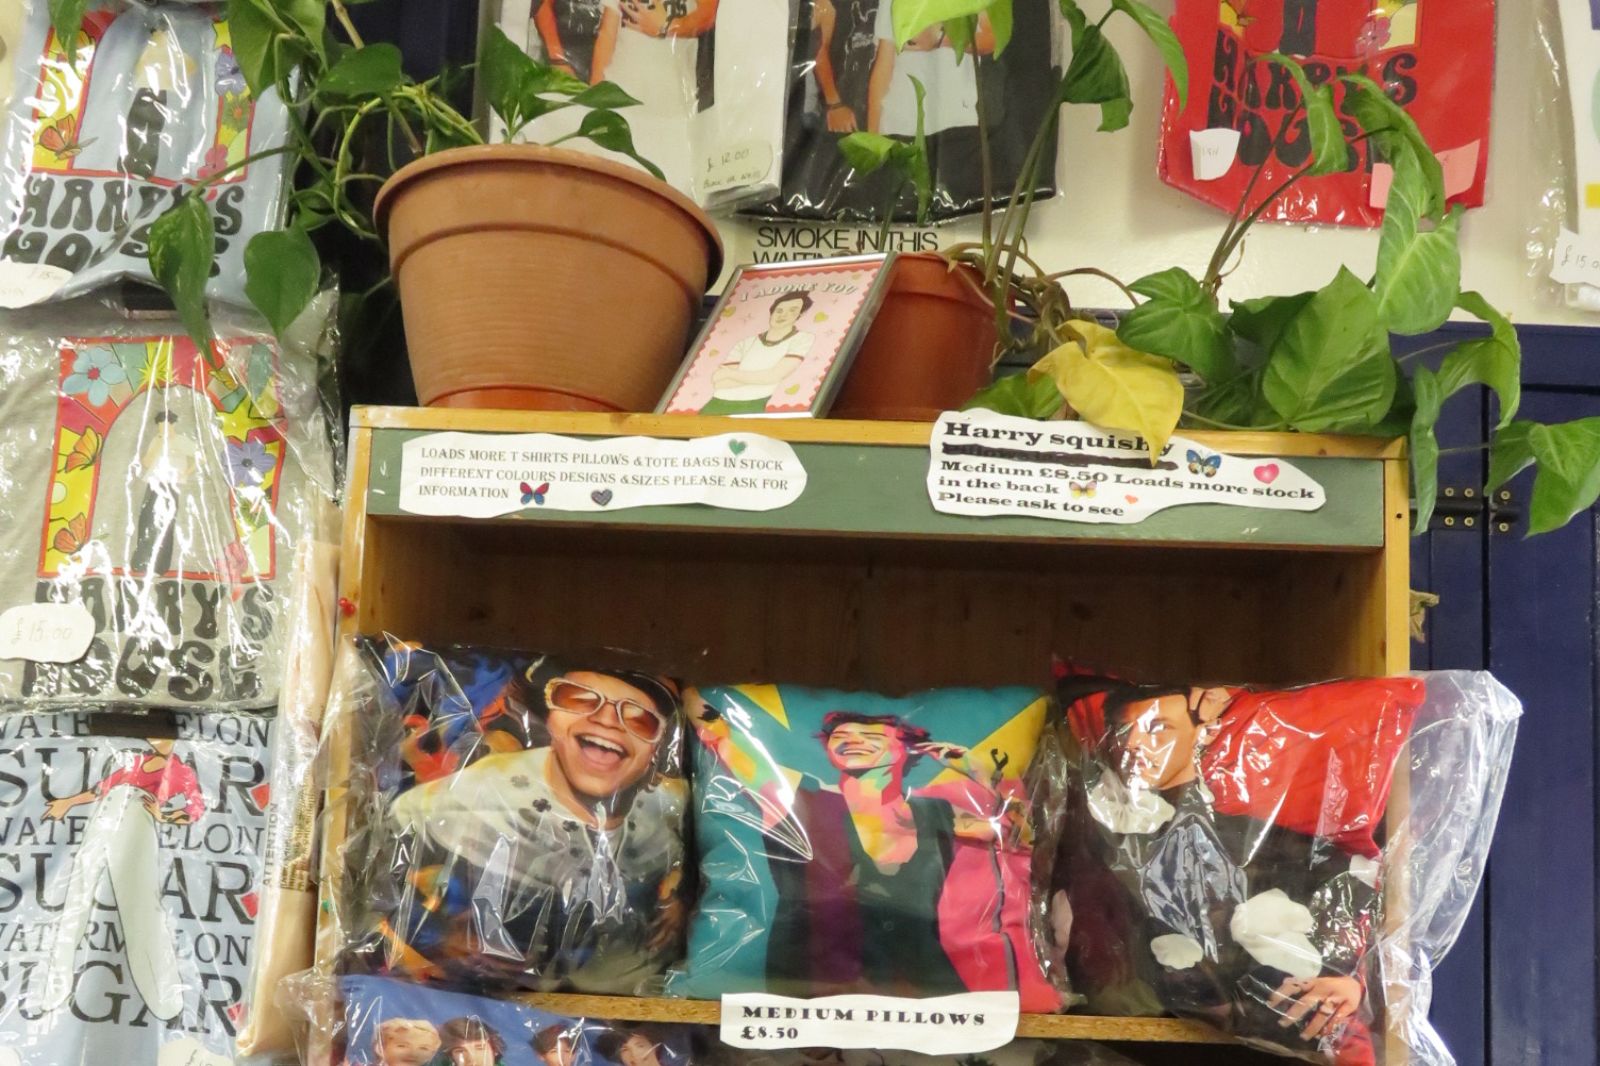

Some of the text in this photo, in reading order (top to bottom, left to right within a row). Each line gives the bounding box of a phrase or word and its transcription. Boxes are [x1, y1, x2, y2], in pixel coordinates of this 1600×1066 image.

[757, 225, 938, 254] SMOKE IN THIS
[756, 283, 818, 299] ADORE
[823, 282, 858, 294] YOU
[944, 422, 1043, 446] Harry
[421, 447, 465, 460] LOADS
[468, 449, 506, 461] MORE
[510, 451, 519, 462] T
[521, 451, 569, 464] SHIRTS
[572, 453, 630, 466] PILLOWS
[682, 457, 720, 468] BAGS
[723, 457, 737, 469] IN
[740, 459, 784, 471] STOCK
[420, 466, 494, 479] DIFFERENT
[496, 469, 557, 482] COLOURS
[560, 471, 617, 484] DESIGNS
[674, 475, 726, 487] PLEASE
[730, 477, 758, 488] ASK
[762, 478, 789, 490] FOR
[939, 476, 1060, 494] in the back
[941, 461, 1315, 499] Medium £8.50 Loads more stock
[419, 484, 509, 499] INFORMATION
[937, 491, 1124, 516] Please ask to see
[742, 1006, 985, 1026] MEDIUM PILLOWS
[740, 1026, 799, 1041] £8.50
